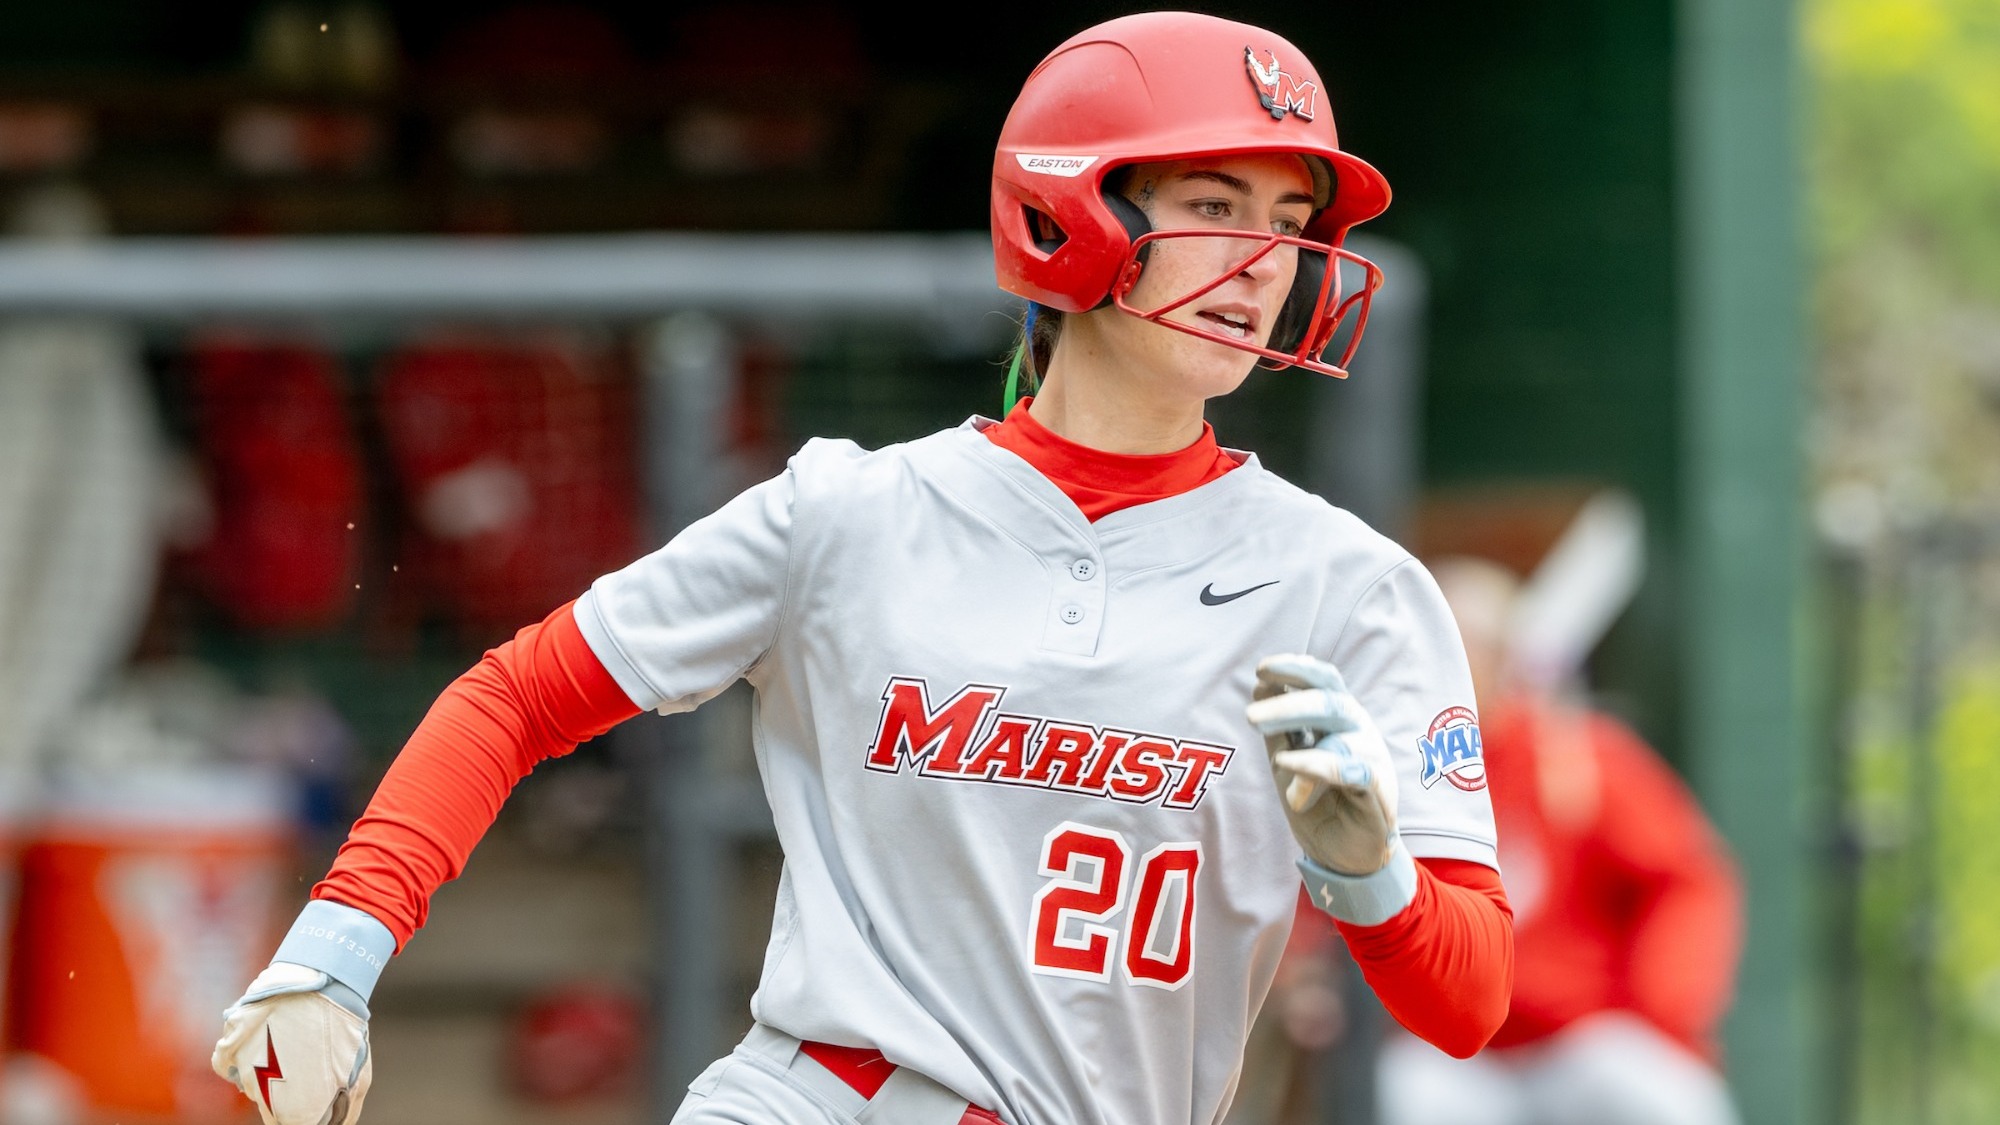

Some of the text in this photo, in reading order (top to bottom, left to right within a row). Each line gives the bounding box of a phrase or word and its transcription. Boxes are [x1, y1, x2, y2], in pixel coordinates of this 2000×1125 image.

[1271, 71, 1317, 120] M
[1028, 158, 1084, 168] EASTON
[865, 676, 1236, 811] MARIST
[1028, 822, 1205, 991] 20
[299, 925, 337, 941] BOLT
